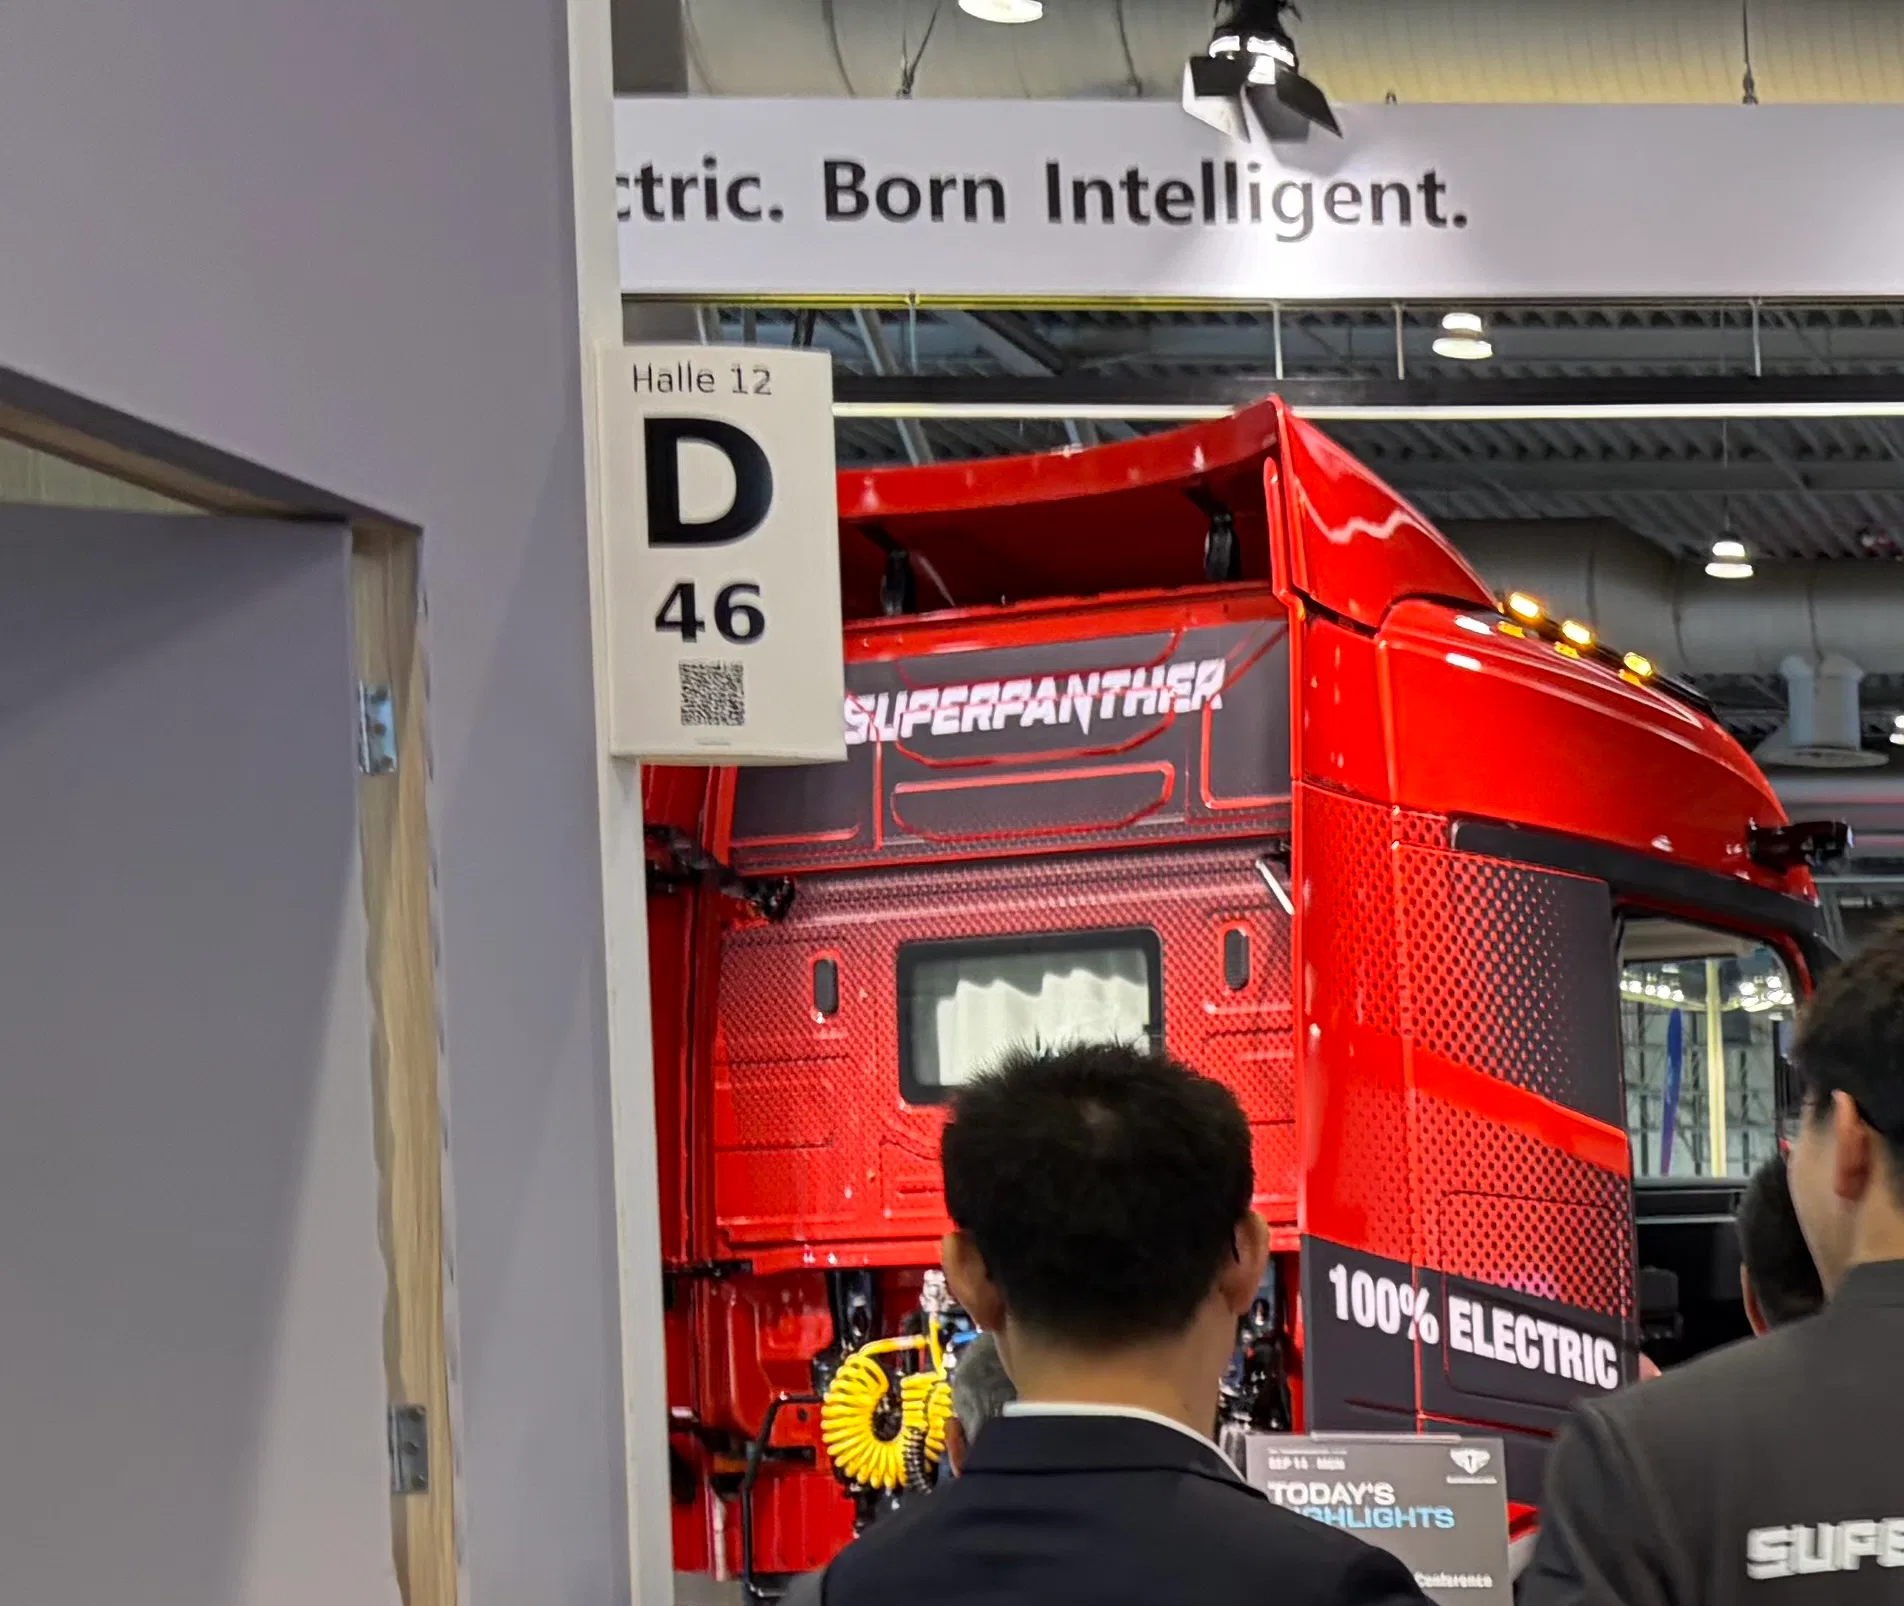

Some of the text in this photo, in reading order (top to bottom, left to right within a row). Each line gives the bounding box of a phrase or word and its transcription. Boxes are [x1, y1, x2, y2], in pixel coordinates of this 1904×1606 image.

[823, 156, 1007, 224] Born
[1045, 158, 1468, 243] Intelligent.
[632, 361, 773, 395] Halle 12
[643, 417, 774, 549] D
[655, 582, 766, 645] 46
[844, 657, 1227, 745] SUPERPANTHER
[1328, 1262, 1619, 1391] 100% ELECTRIC
[1266, 1481, 1396, 1506] TODAY'S
[1292, 1505, 1456, 1529] GHLIGHTS
